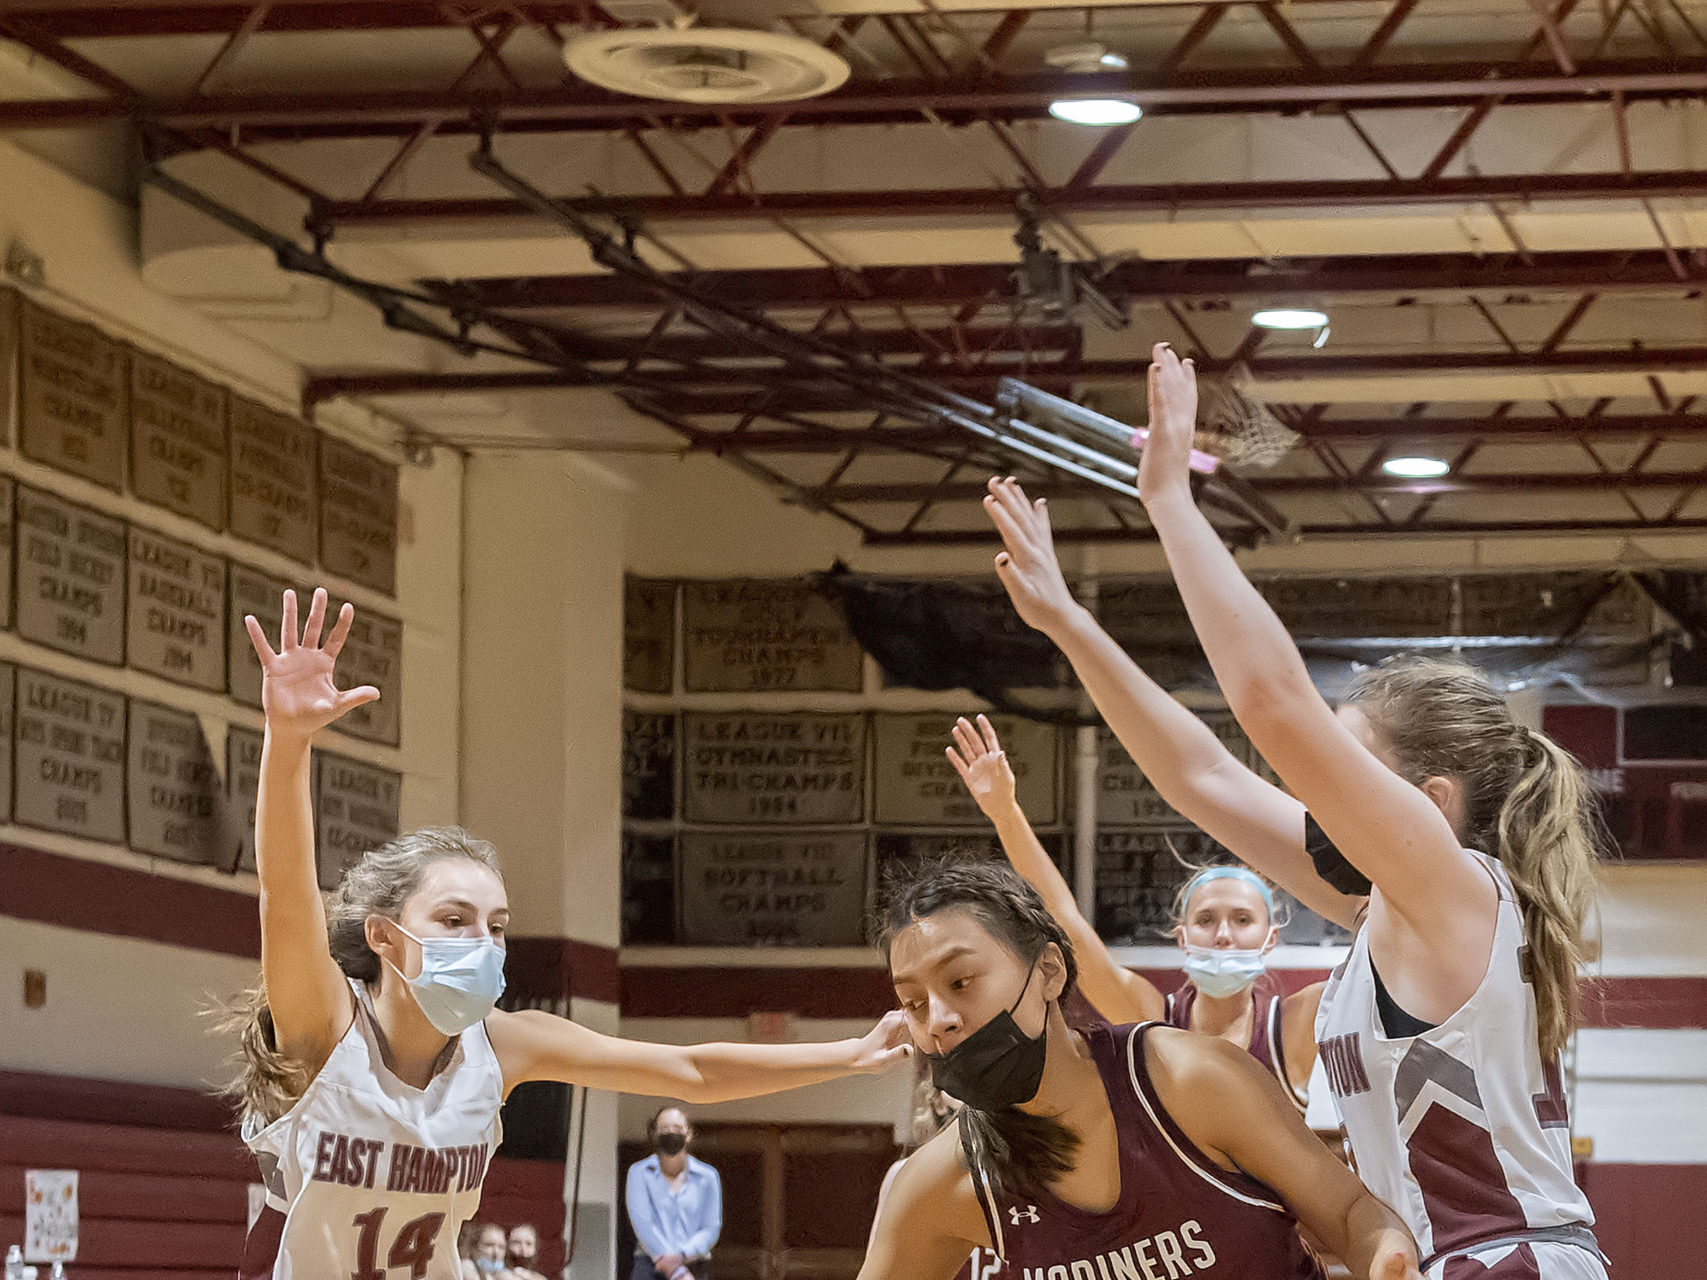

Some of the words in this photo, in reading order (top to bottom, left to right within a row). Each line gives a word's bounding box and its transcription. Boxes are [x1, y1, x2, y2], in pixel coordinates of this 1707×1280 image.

[698, 721, 802, 741] LEAGUE
[311, 1130, 384, 1190] EAST
[386, 1141, 489, 1194] HAMPTON
